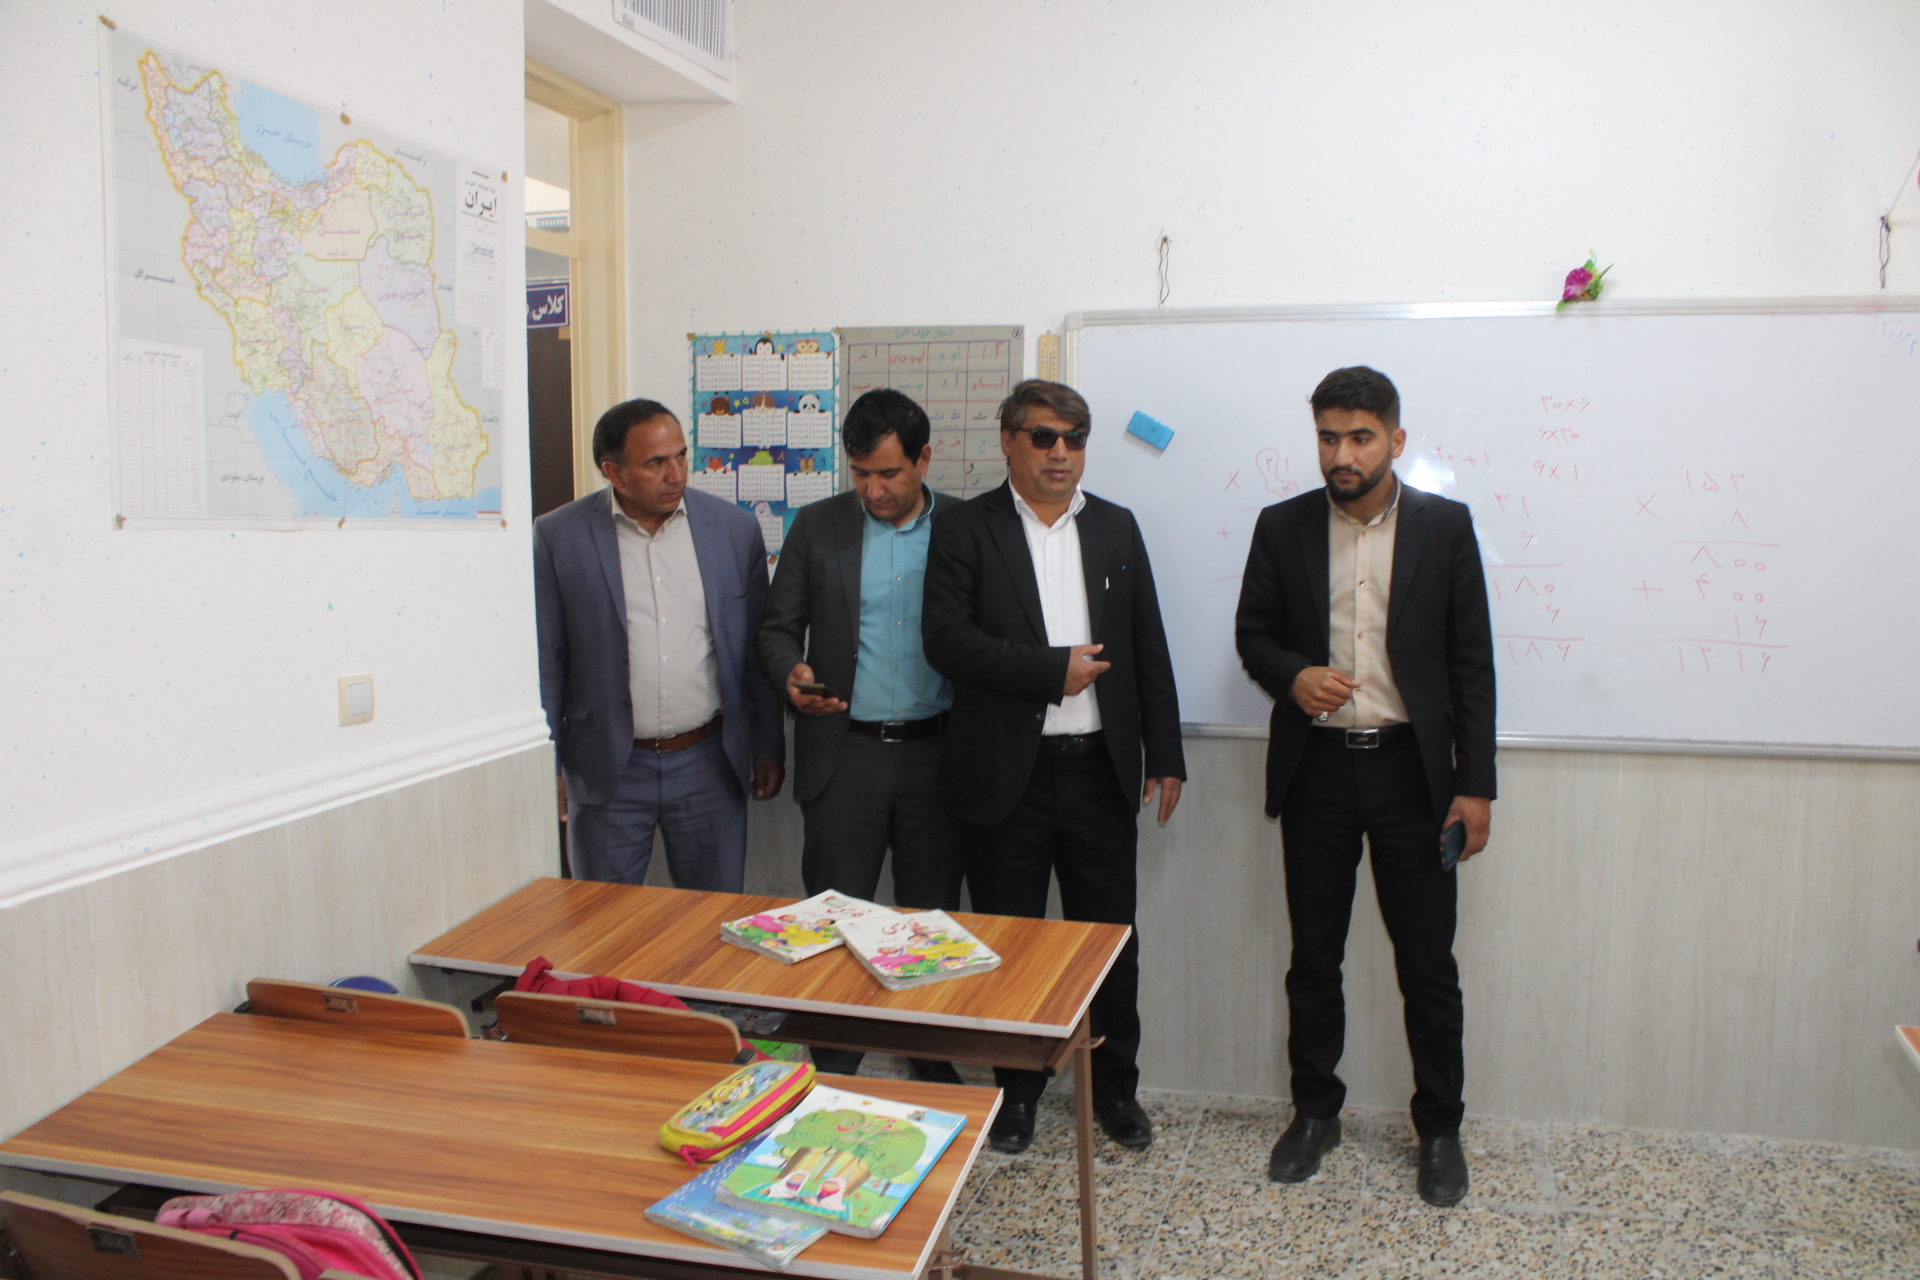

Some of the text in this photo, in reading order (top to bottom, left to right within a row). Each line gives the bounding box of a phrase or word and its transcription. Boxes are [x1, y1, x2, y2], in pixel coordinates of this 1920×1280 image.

[464, 189, 498, 218] ایران
[532, 293, 565, 322] کلاس
[835, 1114, 898, 1134] قرآن
